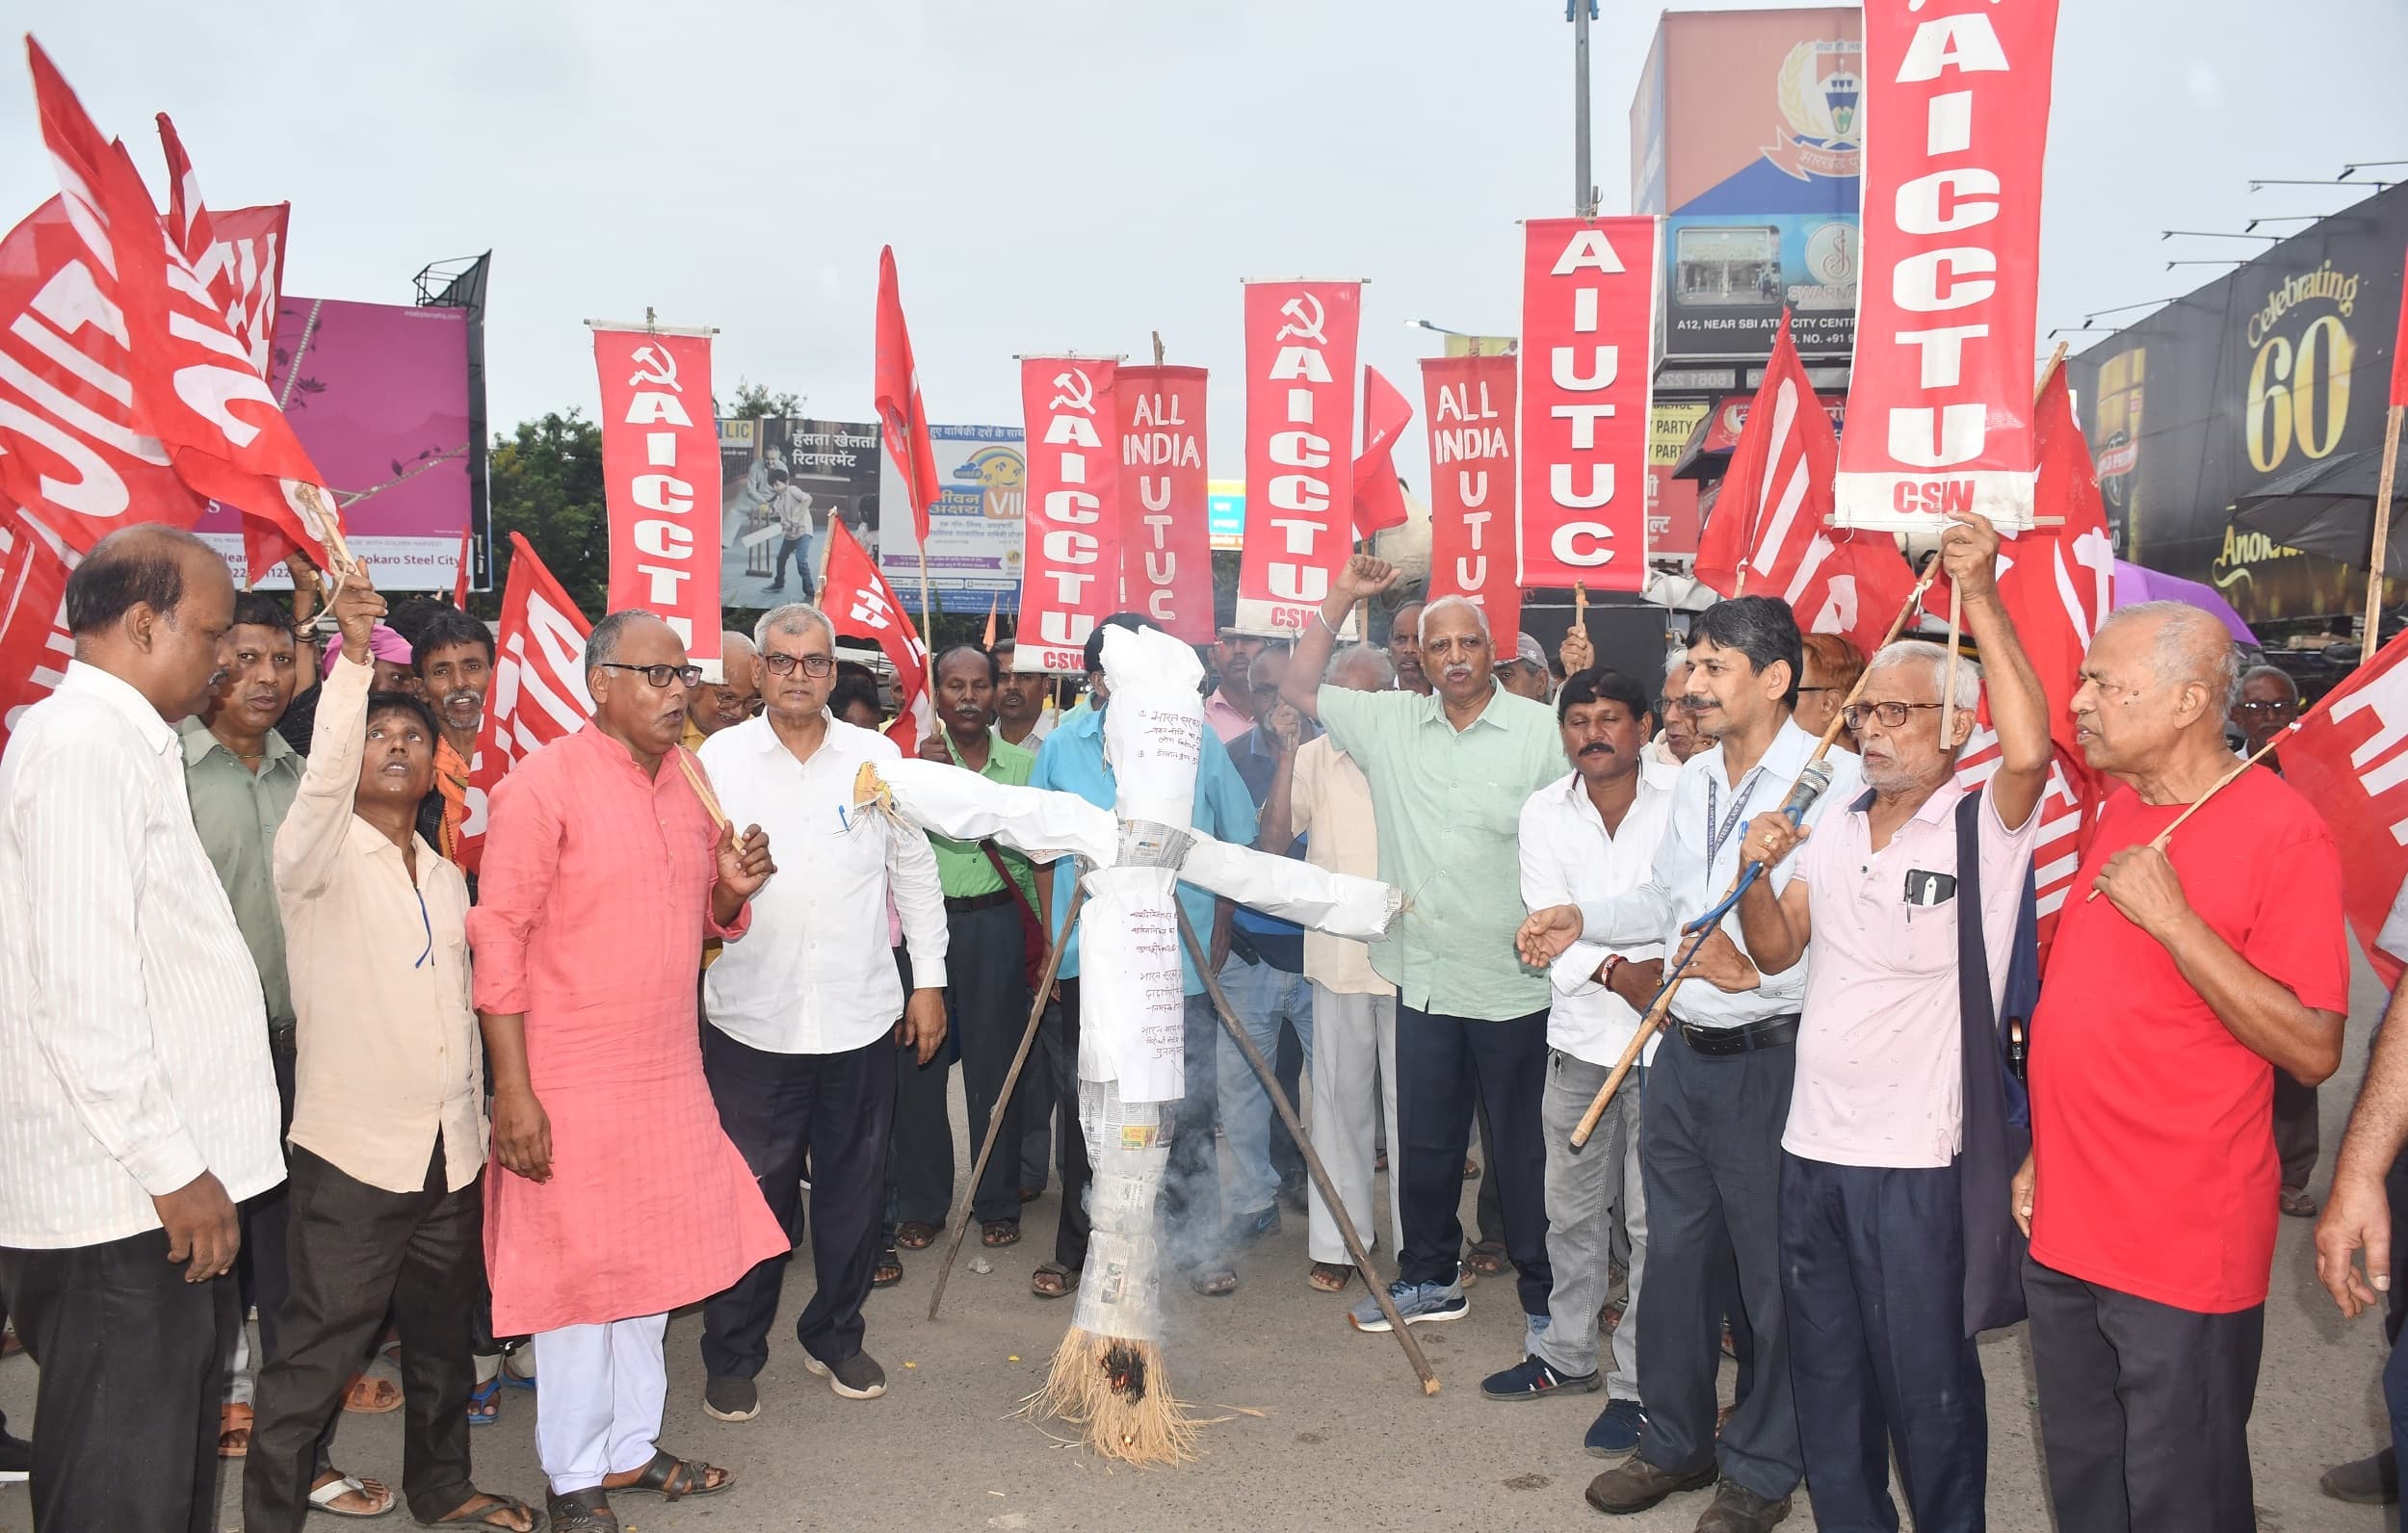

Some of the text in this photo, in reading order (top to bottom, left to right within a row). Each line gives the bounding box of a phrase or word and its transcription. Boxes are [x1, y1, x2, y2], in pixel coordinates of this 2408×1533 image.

[1888, 13, 2010, 468] AICCTU
[2248, 259, 2359, 349] Celebrating
[1677, 320, 1701, 331] A12,
[1704, 319, 1736, 329] NEAR
[1739, 319, 1758, 328] SBI
[1791, 318, 1818, 328] CITY
[1803, 333, 1822, 344] NO.
[1825, 333, 1844, 344] +91
[1133, 393, 1186, 426] ALL
[1436, 380, 1499, 422] ALL
[1551, 229, 1626, 566] AIUTUC
[2245, 315, 2355, 473] 60
[725, 424, 749, 438] LIC
[833, 430, 877, 449] खेलता
[1657, 420, 1692, 434] PARTY
[792, 450, 856, 467] रिटायरमेंट
[1123, 432, 1201, 470] INDIA
[1434, 427, 1509, 464] INDIA
[1656, 445, 1686, 458] PART
[1268, 346, 1333, 603] AICCTU
[1893, 480, 1976, 514] CSW
[1040, 414, 1103, 645] AICCTU
[404, 555, 434, 565] Steel
[437, 555, 460, 568] City
[1139, 476, 1177, 621] UTUC
